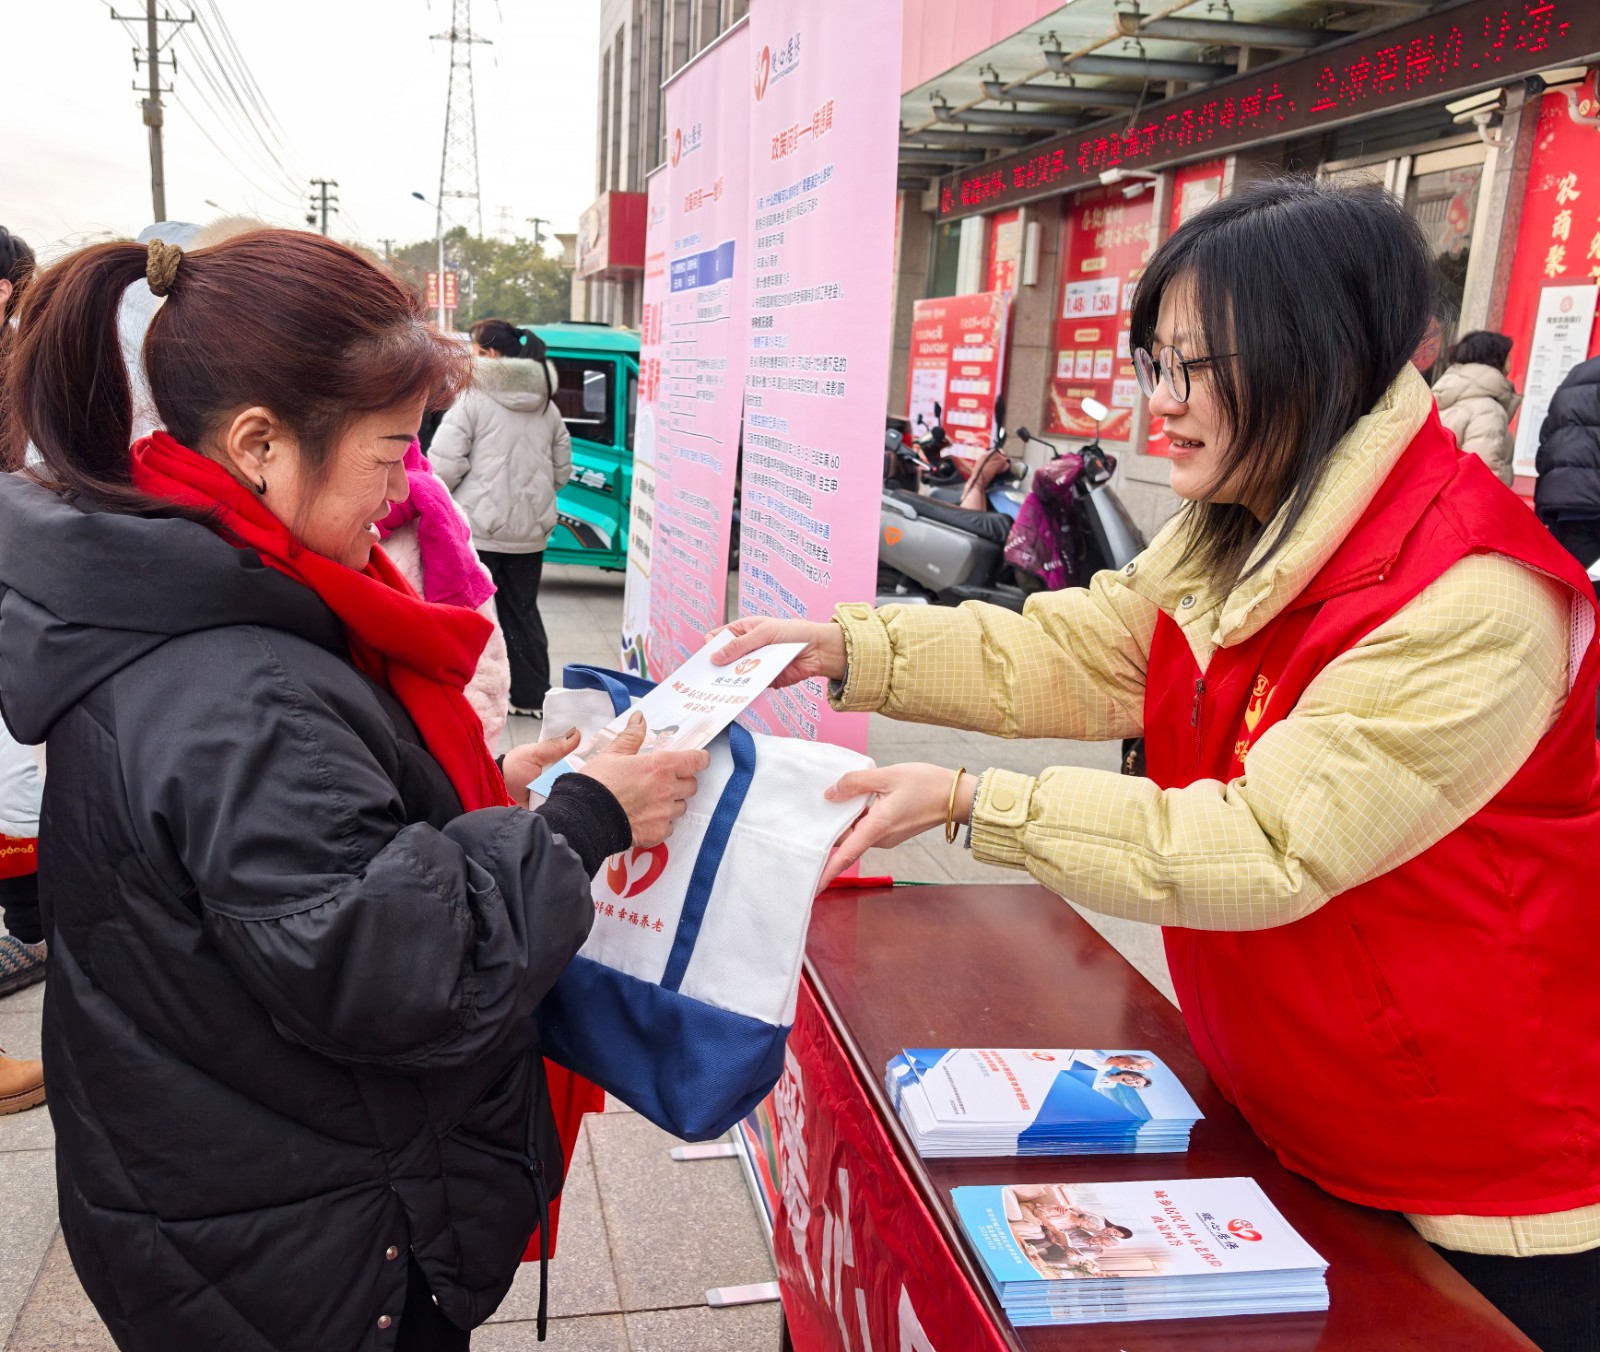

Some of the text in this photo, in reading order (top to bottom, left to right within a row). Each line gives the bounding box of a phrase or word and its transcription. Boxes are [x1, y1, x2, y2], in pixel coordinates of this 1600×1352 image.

[617, 907, 665, 933] 幸福养老
[1153, 1190, 1223, 1267] 城乡居民基本养老保险
